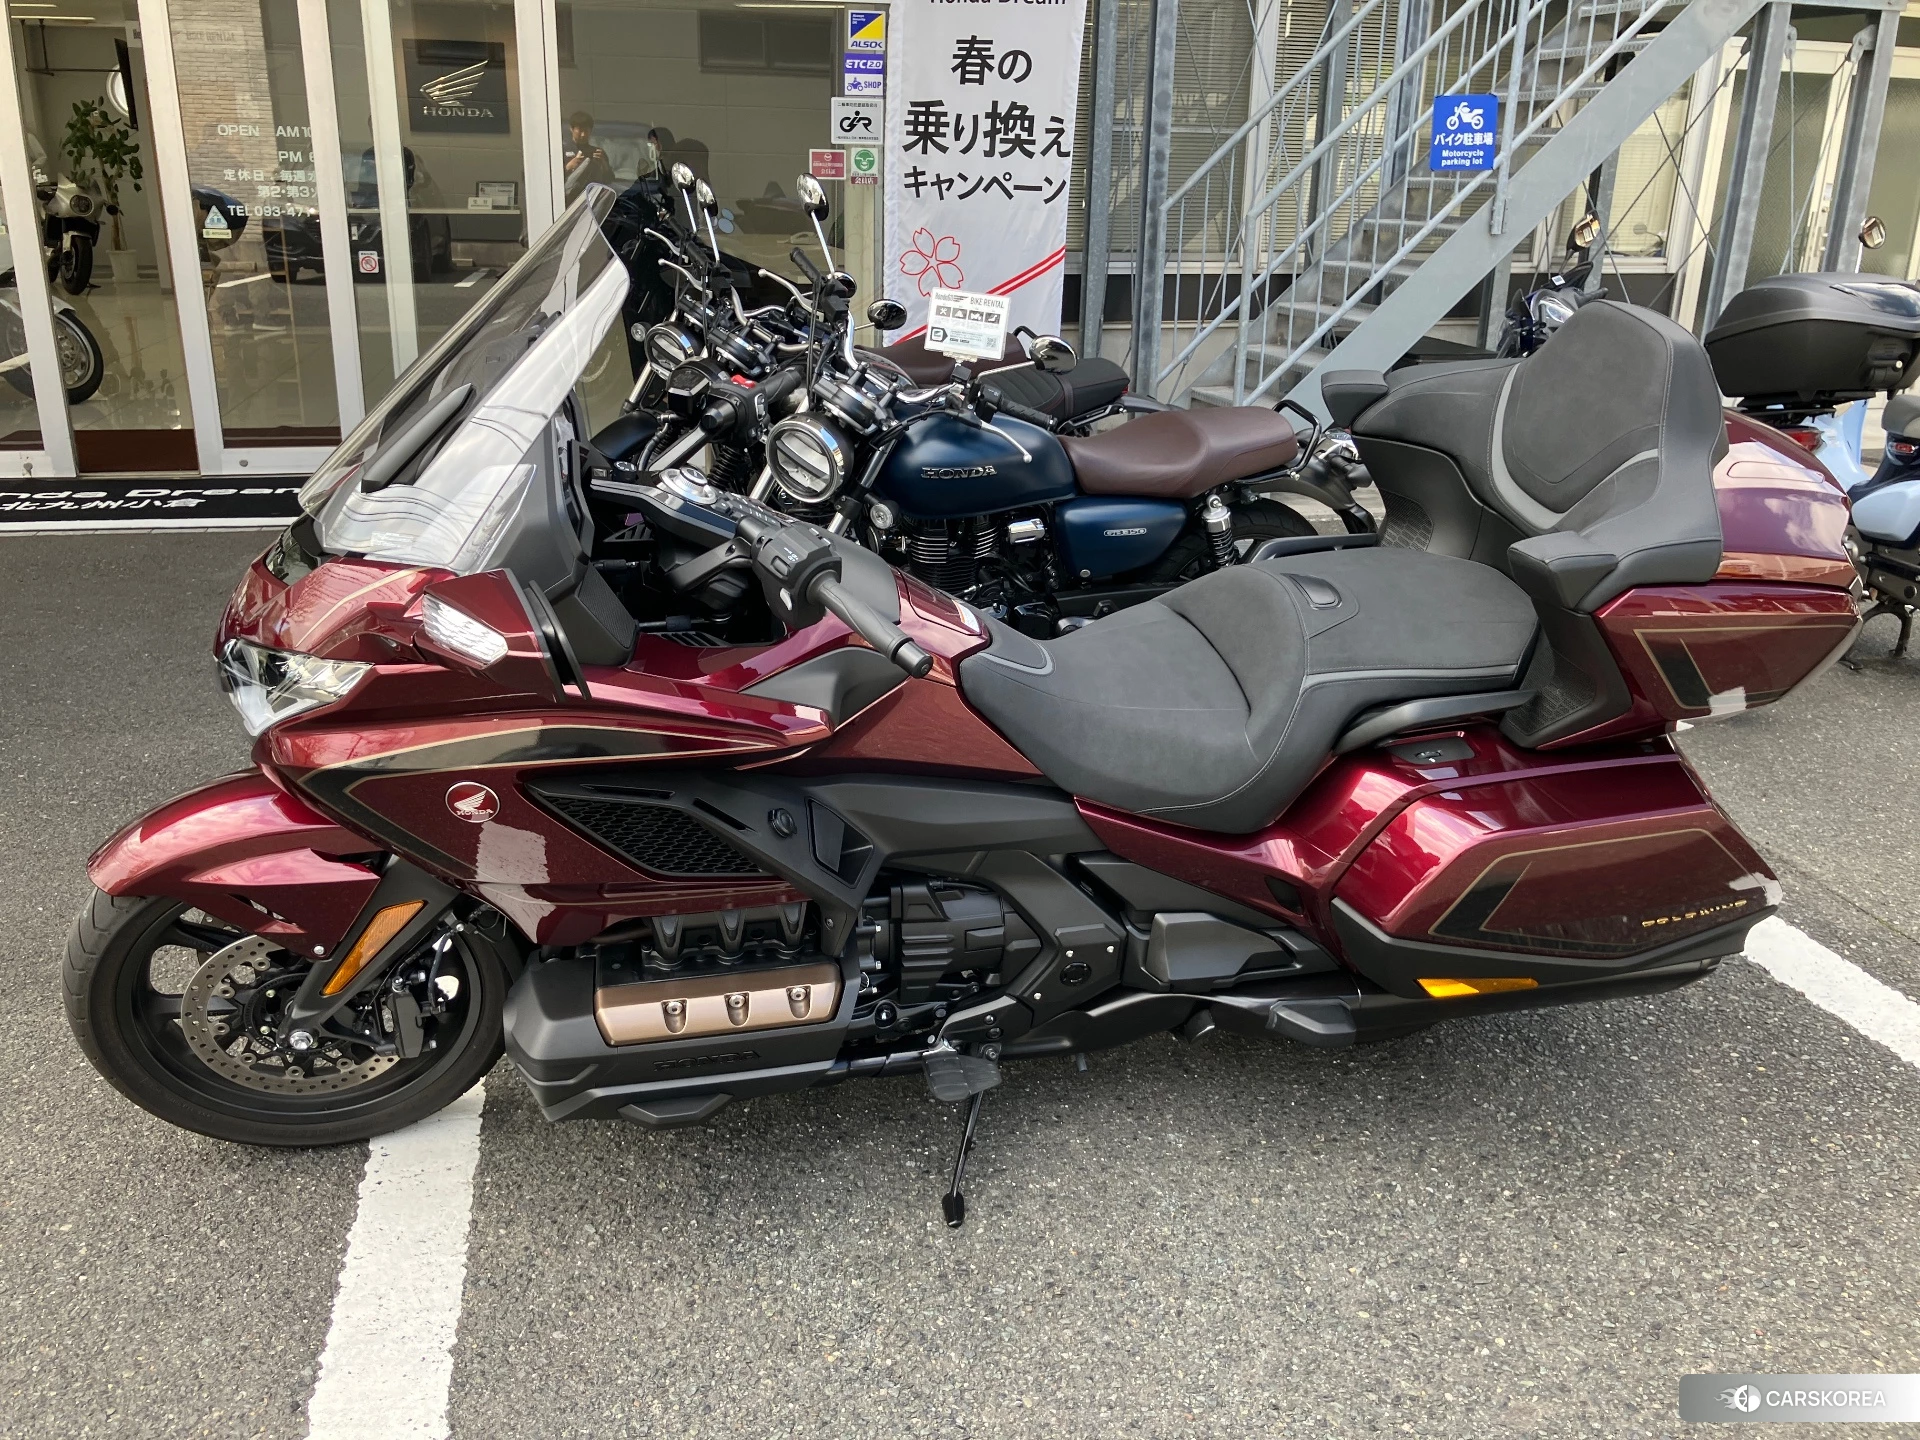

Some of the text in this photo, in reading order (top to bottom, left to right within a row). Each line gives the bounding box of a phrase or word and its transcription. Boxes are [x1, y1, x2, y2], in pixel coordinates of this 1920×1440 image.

[951, 35, 1032, 85] 春の
[424, 106, 494, 117] HONDA
[217, 125, 260, 136] OPEN
[902, 100, 1071, 158] 乗り換え
[1434, 132, 1493, 146] バイク駐車場
[279, 151, 302, 162] PM
[1442, 149, 1484, 158] Motorcycle
[1441, 157, 1482, 167] parking lot
[903, 165, 1067, 204] キャンペーン
[970, 296, 983, 306] BIKE
[983, 298, 1004, 309] RENTAL
[921, 465, 997, 479] HONDA
[456, 808, 494, 816] HONDA
[653, 1050, 760, 1072] HONDA
